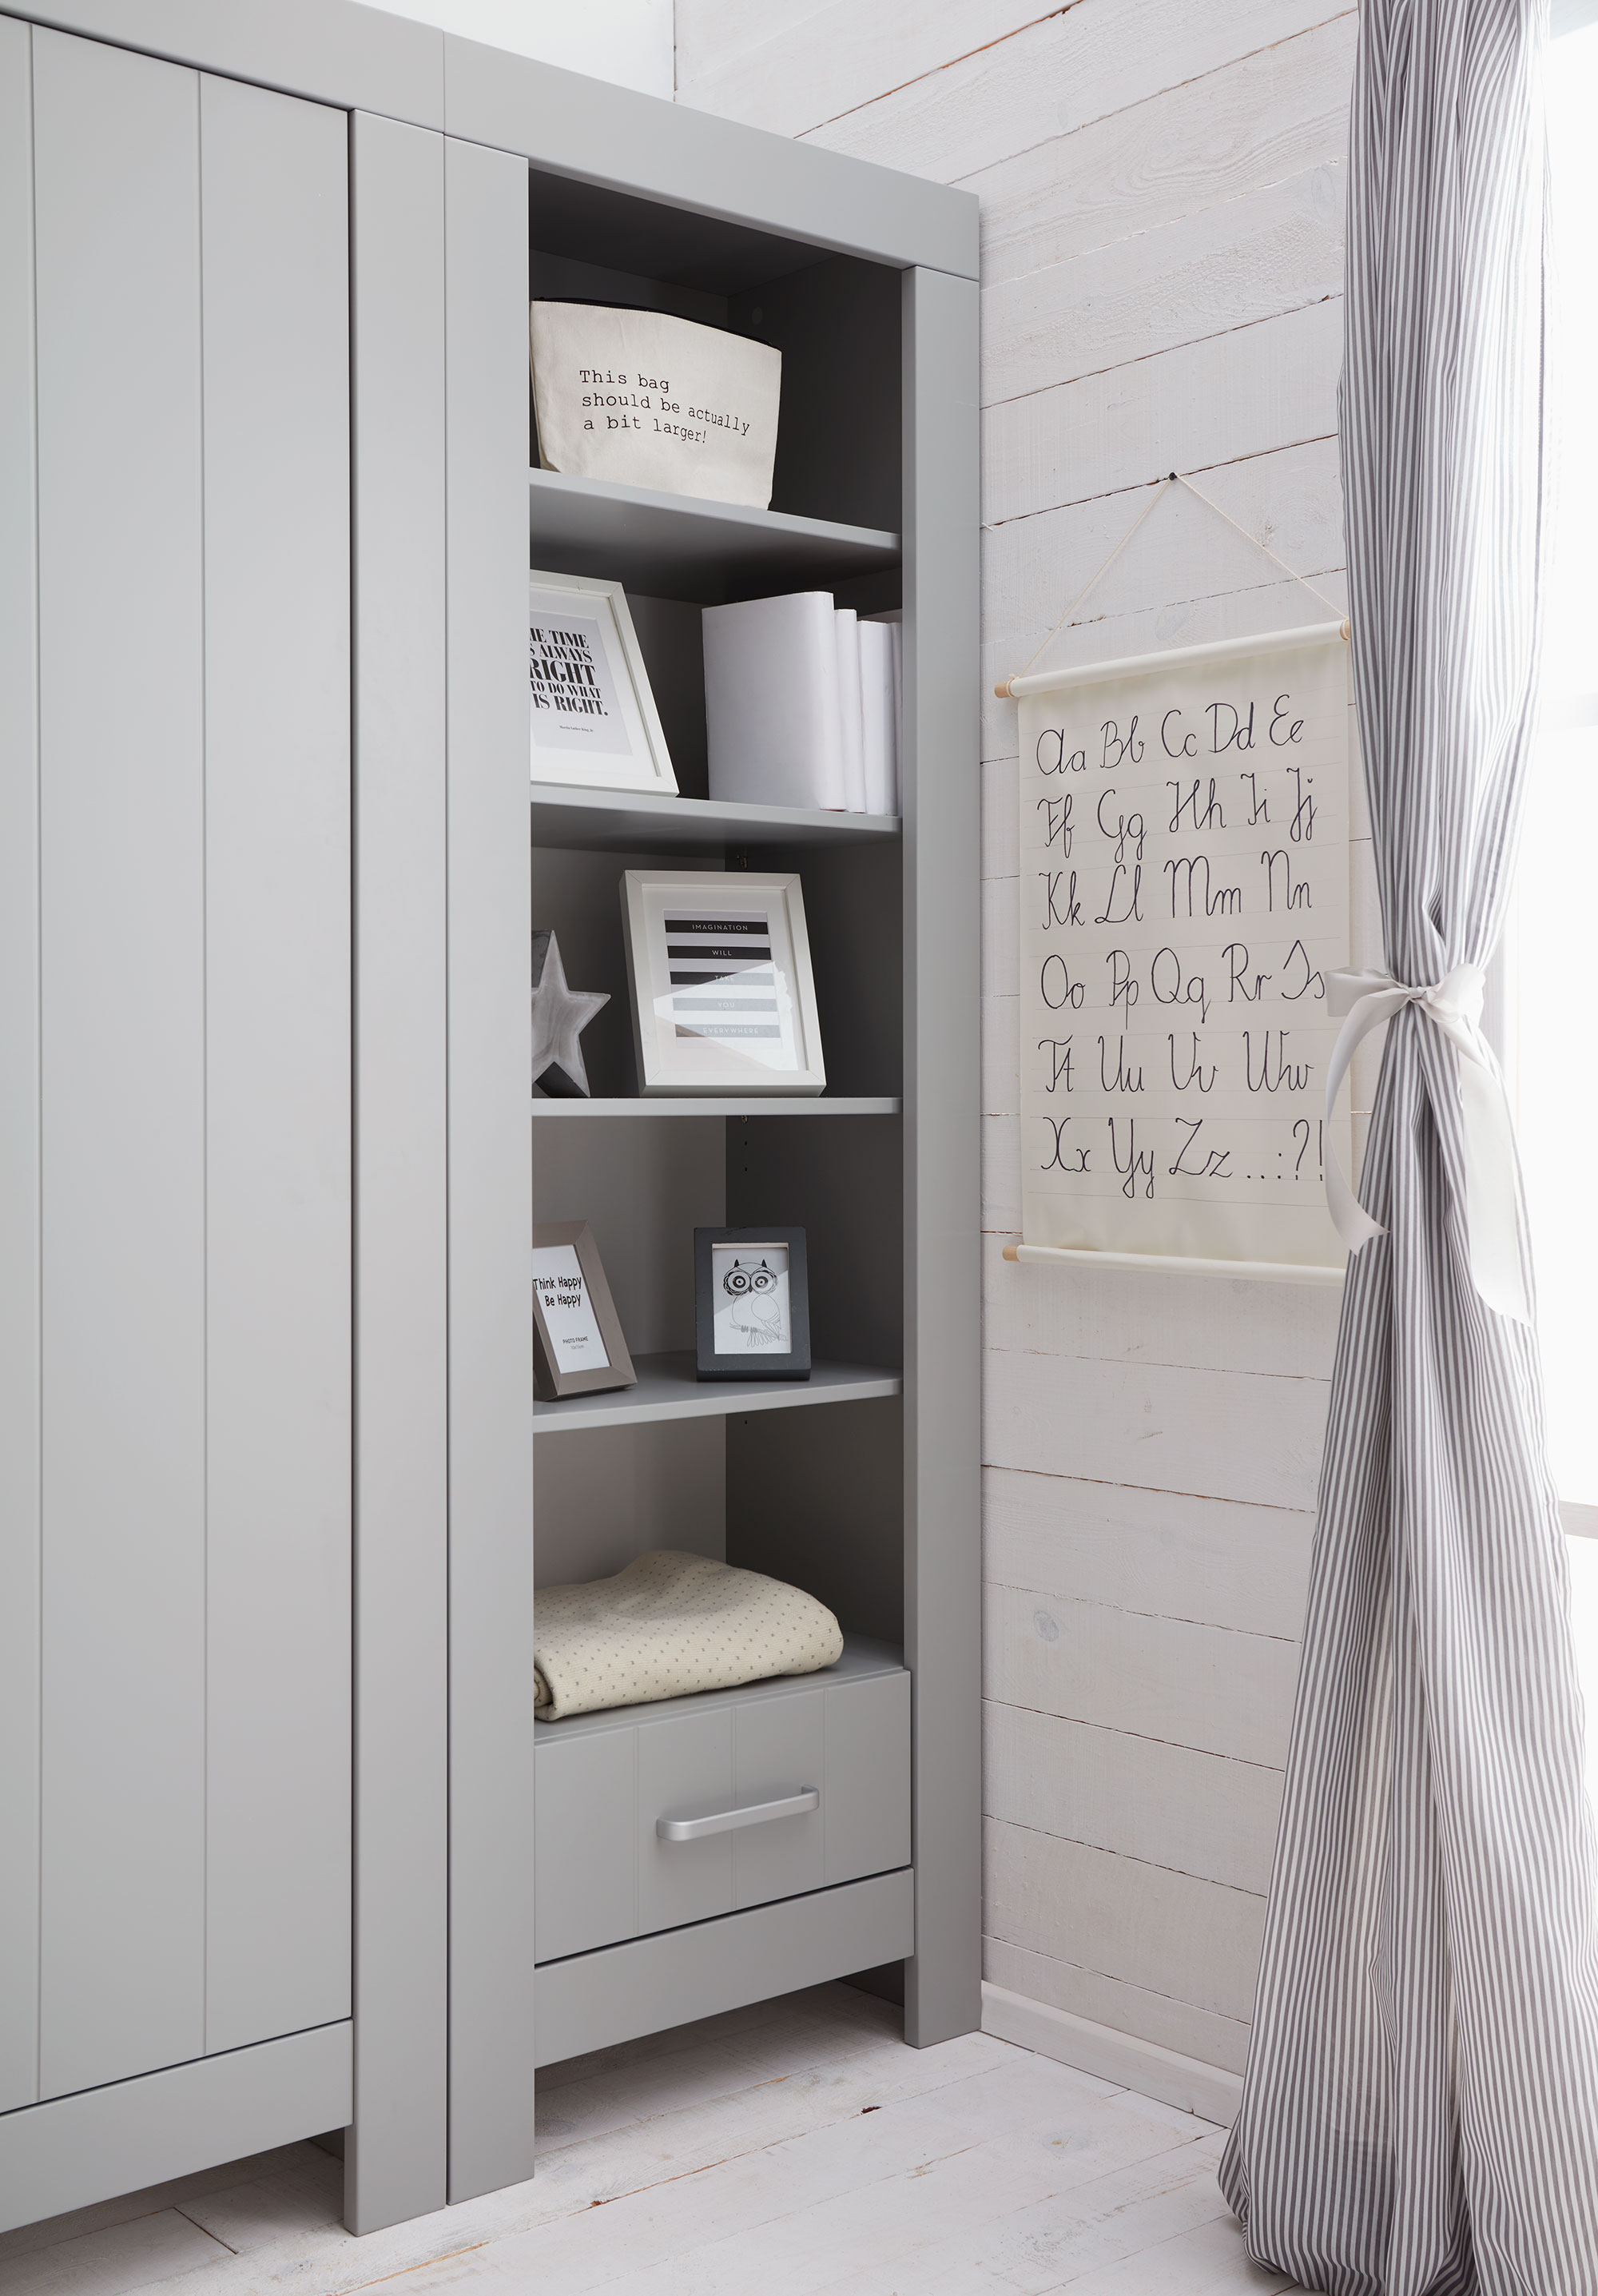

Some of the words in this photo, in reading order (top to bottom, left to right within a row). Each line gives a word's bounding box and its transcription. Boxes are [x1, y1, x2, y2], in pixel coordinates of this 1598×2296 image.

[579, 370, 627, 384] This
[638, 374, 670, 393] bag
[582, 392, 651, 409] should
[660, 397, 680, 413] be
[688, 407, 750, 436] actually
[583, 420, 594, 430] a
[606, 414, 642, 429] bit
[653, 418, 706, 444] larger!
[539, 643, 593, 663] ALWAYS
[548, 630, 589, 649] TIME
[530, 658, 596, 686] RIGHT
[531, 680, 545, 692] TO
[547, 682, 565, 694] DO
[566, 684, 601, 699] WHAT
[532, 693, 551, 710] IS
[554, 695, 609, 716] RIGHT.
[1036, 727, 1087, 776] Aa
[1099, 714, 1145, 770] Bb
[1161, 709, 1198, 758] Cc
[1205, 701, 1256, 754] Dd
[1269, 694, 1304, 746] Ee
[1037, 794, 1075, 859] Ff
[1097, 789, 1147, 864] Gg
[1166, 777, 1227, 833] Hh
[1240, 772, 1271, 826] Ii
[1286, 767, 1318, 842] Jj
[1038, 869, 1086, 930] Kk
[1094, 864, 1144, 924] Ll
[1163, 855, 1242, 919] Mm
[1261, 850, 1313, 912] Nn
[1041, 954, 1086, 1009] Oo
[1106, 949, 1139, 1031] Pp
[1151, 947, 1211, 1024] Qq
[1221, 943, 1273, 1002] Rr
[1281, 939, 1326, 1000] Ss
[1038, 1034, 1075, 1092] Tt
[1098, 1035, 1145, 1092] Uu
[1167, 1031, 1218, 1093] Vv
[1242, 1030, 1314, 1092] Ww
[1039, 1116, 1092, 1172] Xx
[1108, 1117, 1155, 1200] Yy
[1168, 1117, 1234, 1178] Zz
[532, 1277, 556, 1290] Think
[558, 1276, 582, 1291] Happy
[544, 1295, 555, 1307] Be
[557, 1294, 581, 1308] Happy
